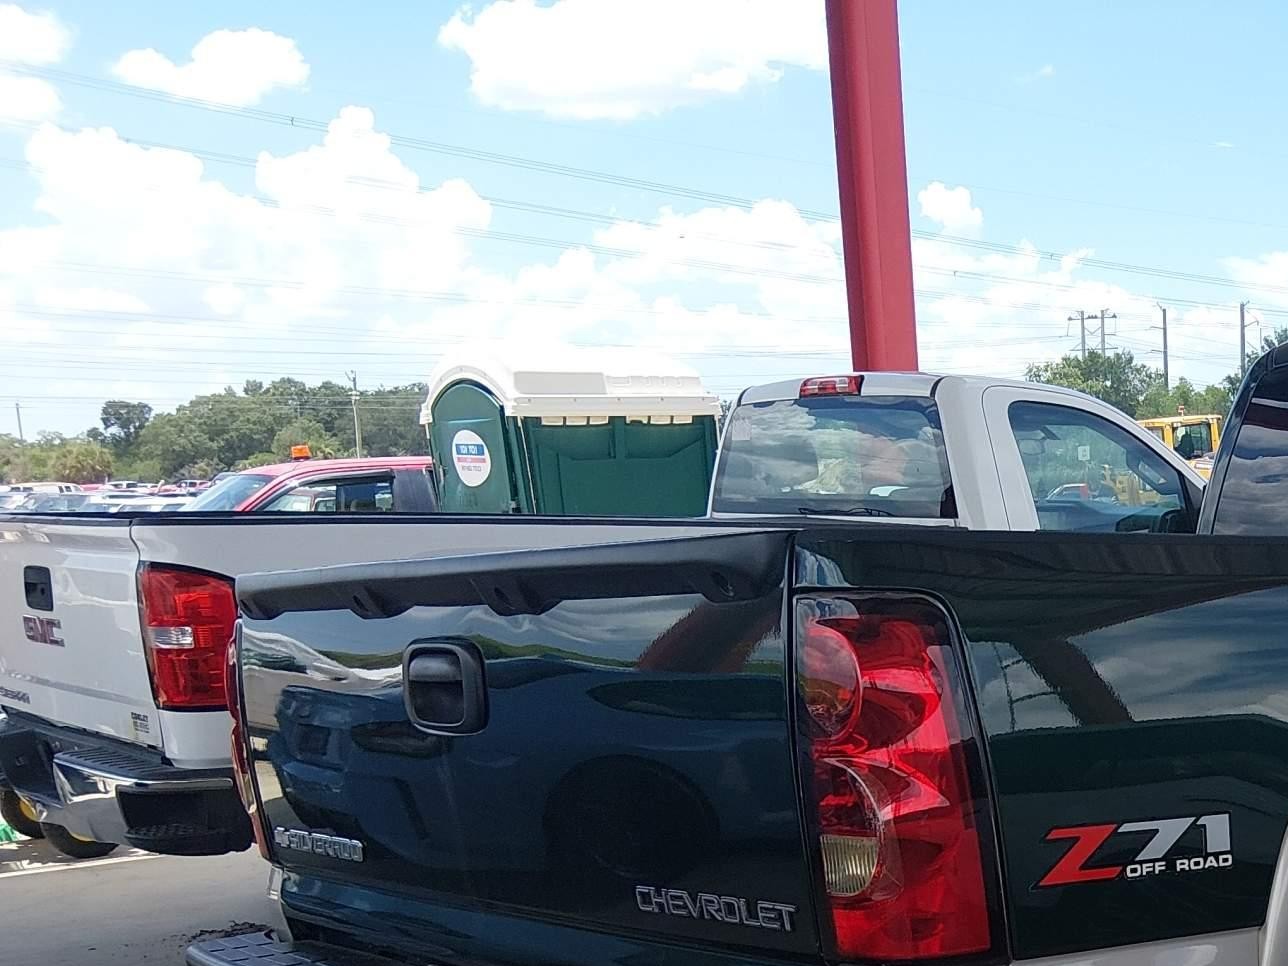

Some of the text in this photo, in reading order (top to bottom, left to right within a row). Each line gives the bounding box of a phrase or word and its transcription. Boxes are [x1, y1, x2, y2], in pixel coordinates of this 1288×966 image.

[288, 828, 364, 862] SILVERADO
[1038, 812, 1231, 887] Z71
[1125, 853, 1233, 878] OFF ROAD
[635, 885, 797, 932] CHEVROLET
